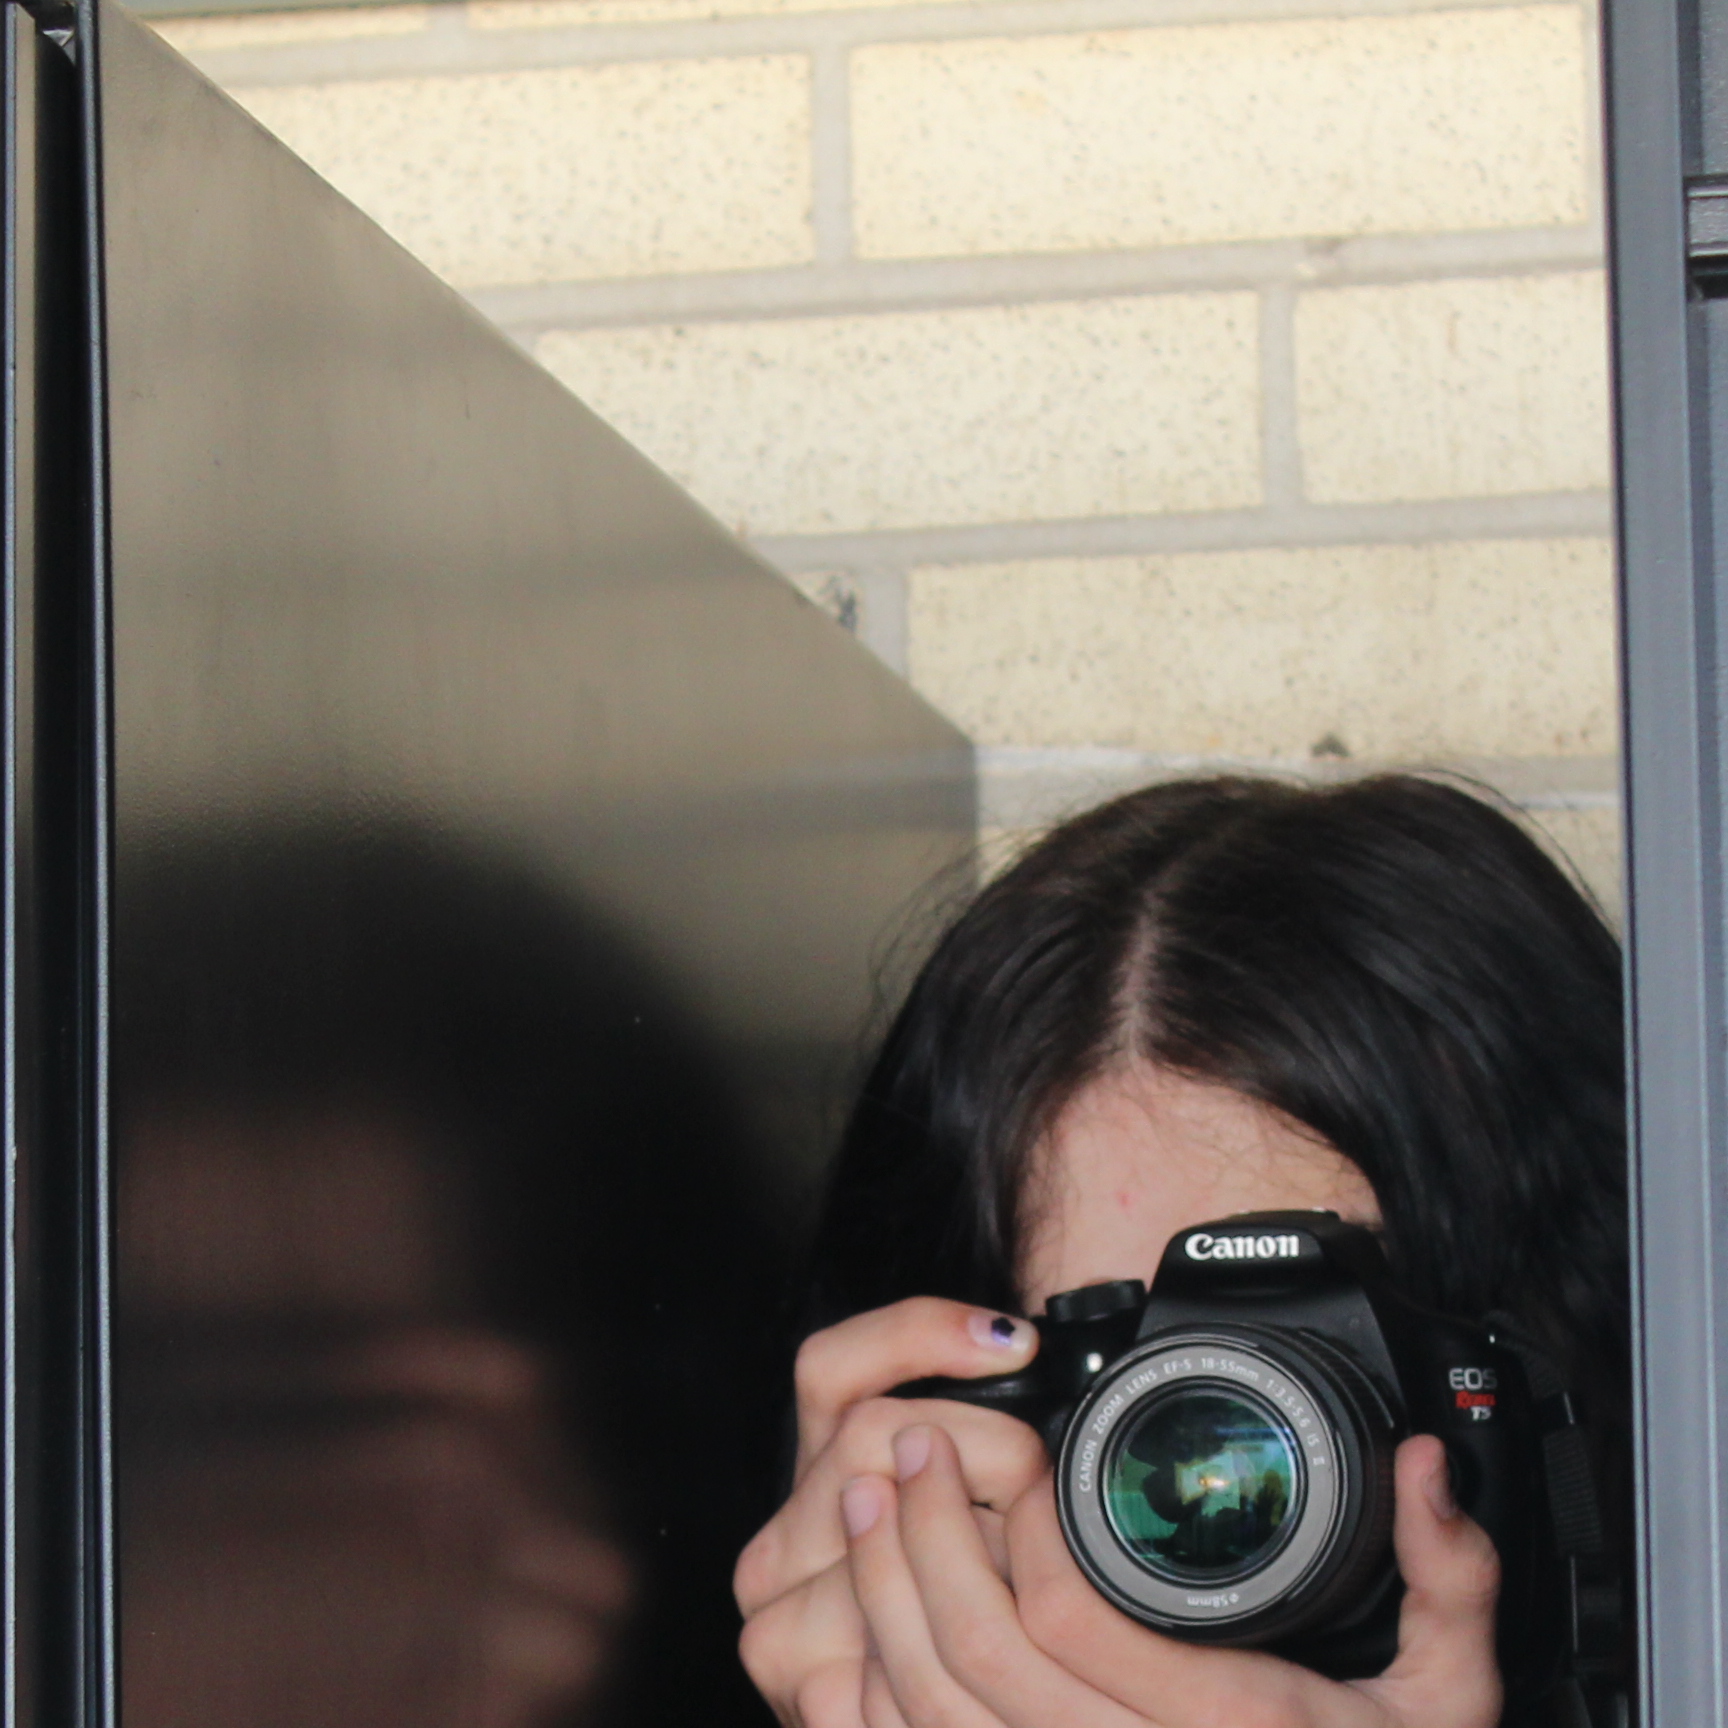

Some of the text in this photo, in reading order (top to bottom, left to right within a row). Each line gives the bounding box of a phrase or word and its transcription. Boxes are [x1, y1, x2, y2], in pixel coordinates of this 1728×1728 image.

[1184, 1232, 1300, 1261] Canon
[1449, 1367, 1498, 1390] EOS
[1079, 1438, 1098, 1493] CANON
[1092, 1393, 1125, 1435] ZOOM
[1125, 1370, 1159, 1396] LENS
